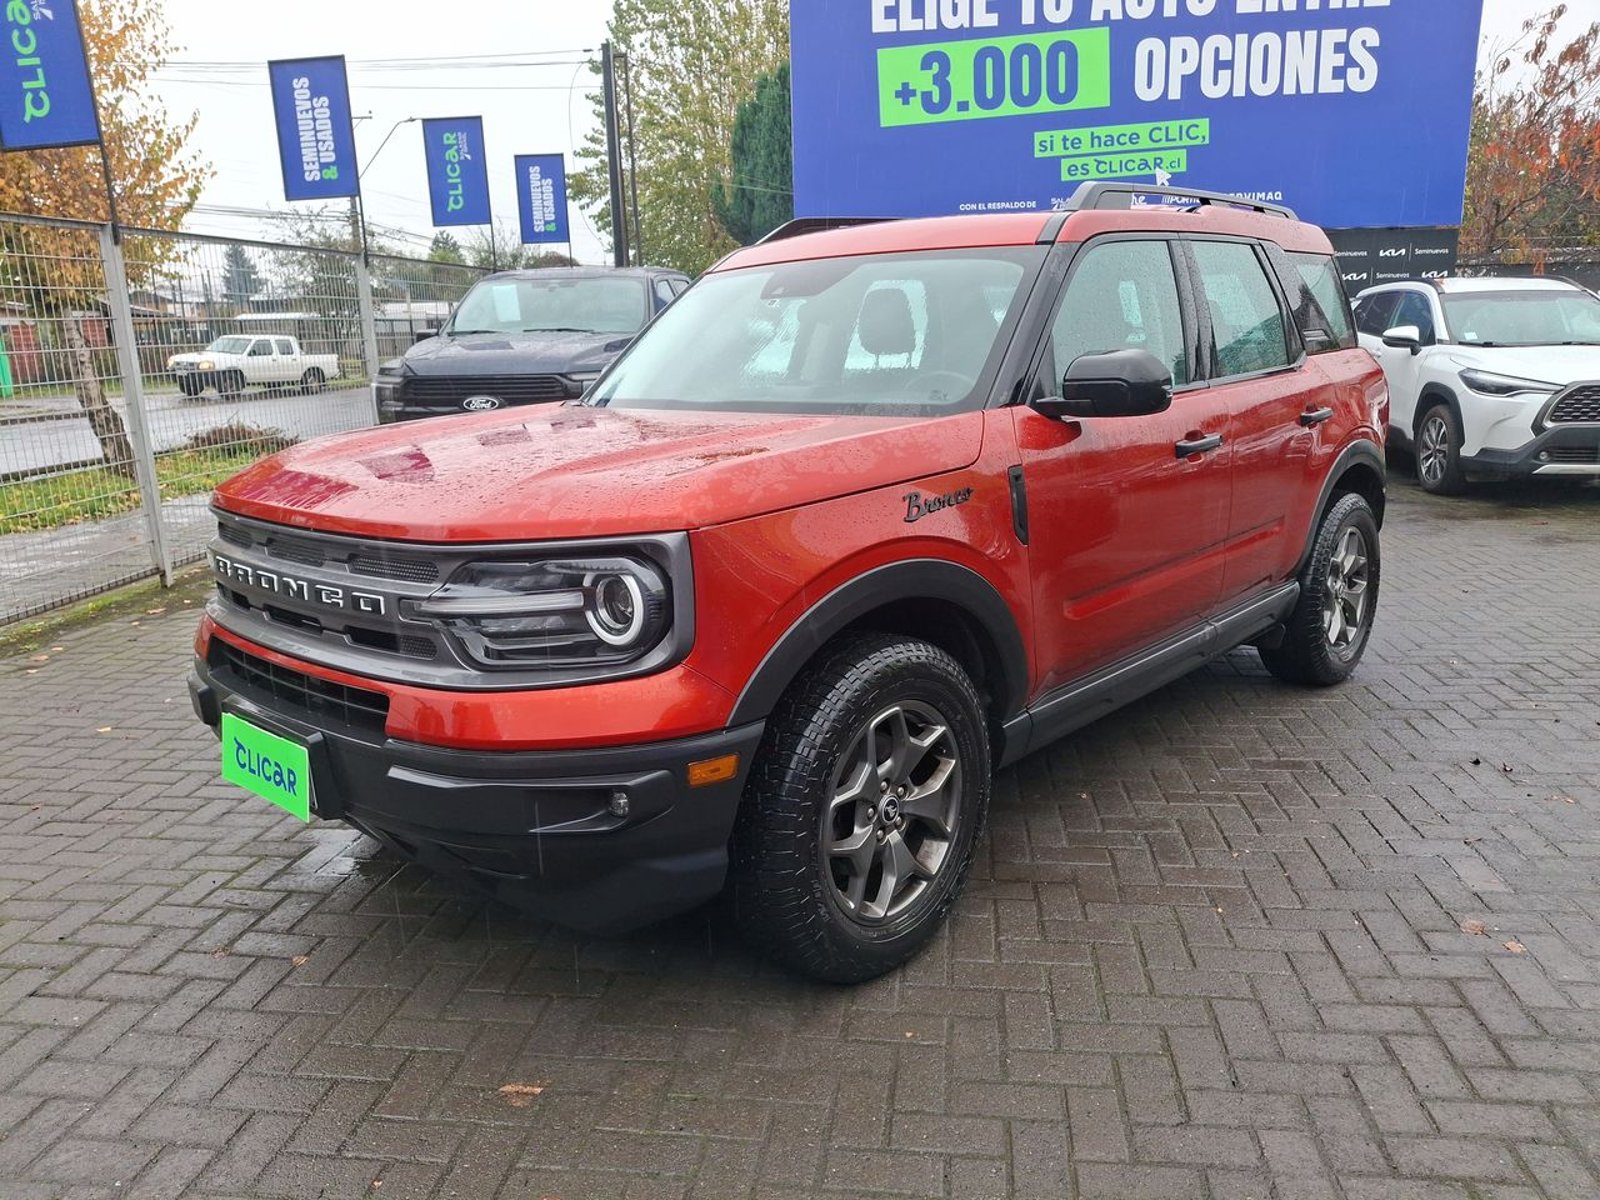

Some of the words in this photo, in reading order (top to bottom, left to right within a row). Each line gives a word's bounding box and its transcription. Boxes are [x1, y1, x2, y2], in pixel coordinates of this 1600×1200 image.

[894, 39, 1078, 116] +3.000
[1134, 27, 1380, 102] OPCIONES
[292, 77, 321, 182] SEMINUEVOS
[312, 96, 336, 163] USADOS
[1038, 135, 1054, 152] si
[1062, 134, 1082, 151] te
[1090, 131, 1140, 148] hace
[1148, 123, 1206, 144] CLIC,
[322, 165, 338, 179] &
[1067, 163, 1090, 177] es
[529, 165, 545, 232] SEMINUEVOS
[541, 178, 555, 221] USADOS
[959, 203, 977, 211] CON
[978, 203, 987, 211] EL
[987, 201, 1026, 210] RESPALDO
[1026, 200, 1037, 208] DE
[544, 222, 557, 232] &
[902, 487, 974, 523] Bronco
[215, 555, 386, 616] BRONCO
